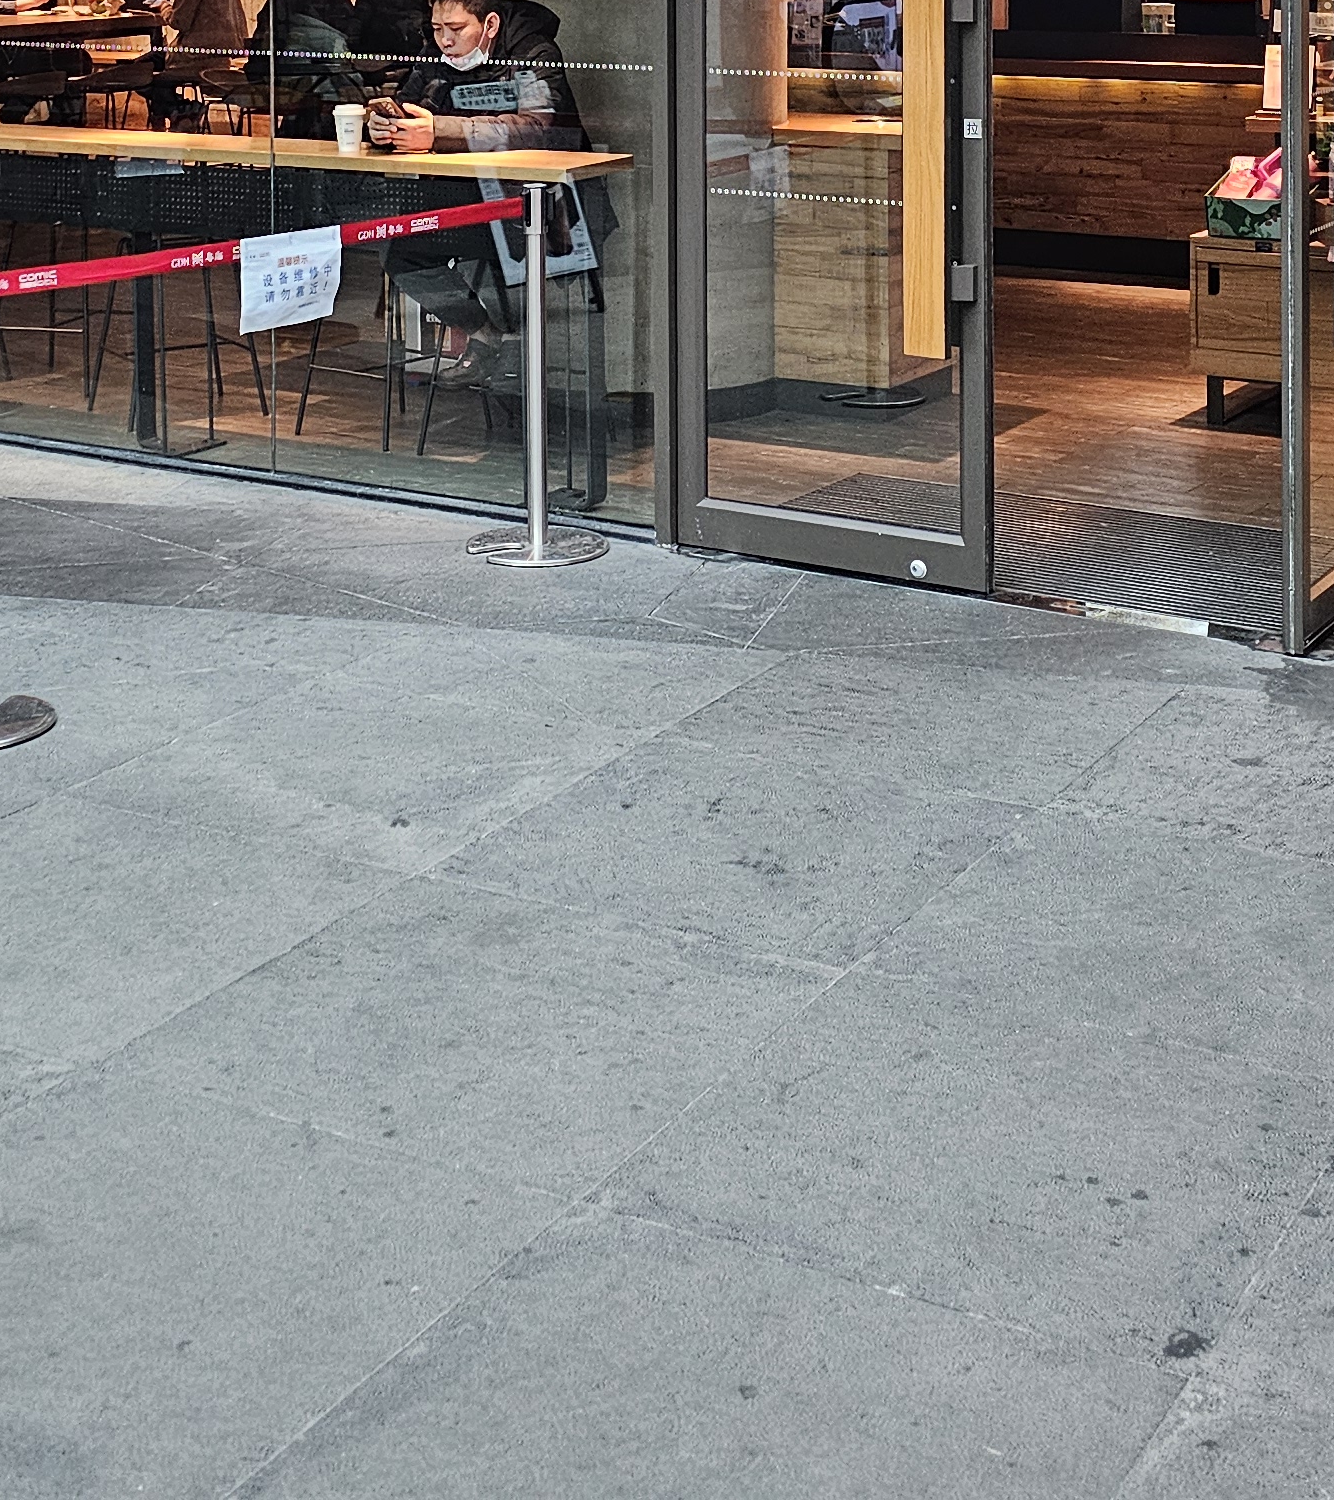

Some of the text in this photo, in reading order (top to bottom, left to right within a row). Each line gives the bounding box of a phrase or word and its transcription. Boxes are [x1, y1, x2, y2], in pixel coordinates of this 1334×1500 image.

[967, 122, 978, 136] 拉
[263, 264, 332, 288] 设备维修中
